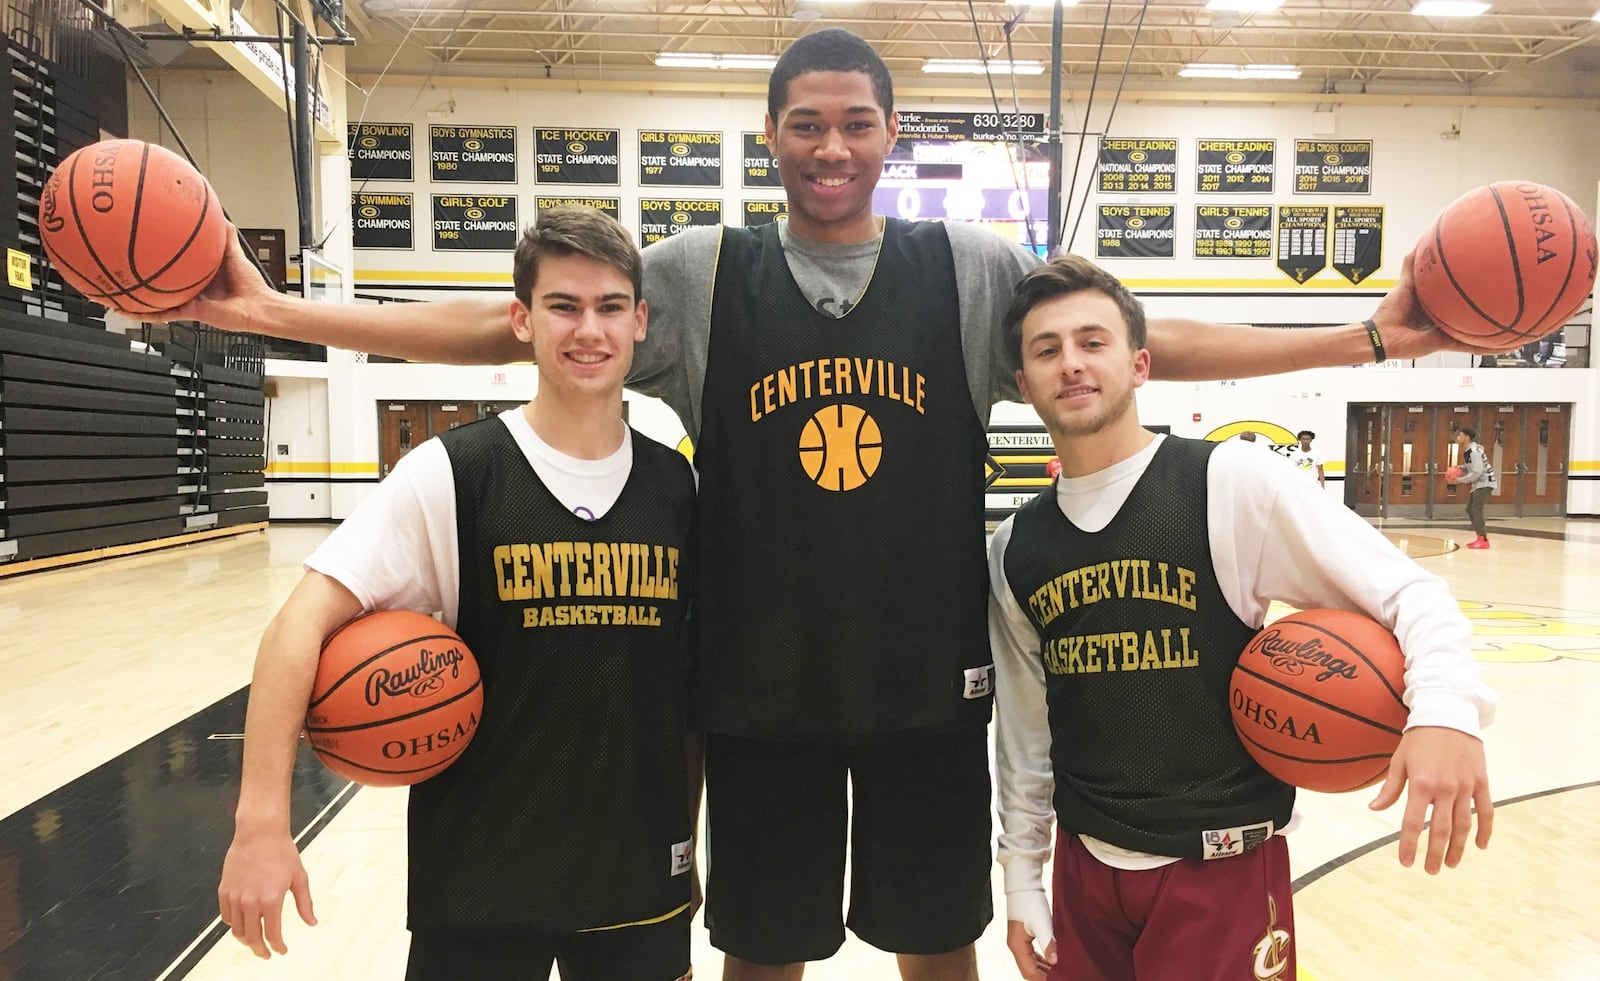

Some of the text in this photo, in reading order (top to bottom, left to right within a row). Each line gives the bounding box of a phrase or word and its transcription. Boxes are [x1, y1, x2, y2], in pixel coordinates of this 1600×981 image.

[362, 126, 409, 136] BOWLING
[433, 128, 513, 139] BOYS GYMNASTICS
[542, 131, 611, 141] ICE HOCKEY
[641, 133, 720, 144] GIRLS GYMNASTICS
[1103, 141, 1175, 150] CHEERLEADING
[1200, 142, 1273, 151] CHEERLEADING
[1297, 143, 1369, 152] GIRLS CROSS COUNTRY
[358, 149, 411, 160] CHAMPIONS
[433, 152, 514, 163] STATE CHAMPIONS
[537, 154, 617, 164] STATE CHAMPIONS
[641, 156, 720, 167] STATE CHAMPIONS
[744, 158, 769, 168] STATE
[881, 165, 918, 178] LACK
[1100, 164, 1175, 173] NATIONAL CHAMPIONS
[1198, 164, 1273, 173] STATE CHAMPIONS
[1295, 166, 1370, 175] STATE CHAMPIONS
[1103, 173, 1124, 181] 2008
[1226, 175, 1245, 183] 2012
[1251, 175, 1270, 183] 2014
[1299, 175, 1317, 183] 2014
[1153, 182, 1172, 190] 2015
[360, 195, 411, 206] SWIMMING
[440, 197, 508, 207] GIRLS GOLF
[539, 199, 561, 209] BOYS
[642, 201, 720, 211] BOYS SOCCER
[747, 203, 779, 212] GIRLS
[1103, 207, 1171, 216] BOYS TENNIS
[1200, 207, 1269, 217] GIRLS TENNIS
[358, 218, 410, 229] CHAMPIONS
[435, 221, 516, 231] STATE CHAMPIONS
[642, 224, 667, 233] STATE
[1516, 184, 1557, 266] OHSAA
[439, 231, 458, 239] 1995
[1099, 229, 1173, 239] STATE CHAMPIONS
[1196, 229, 1271, 239] STATE CHAMPIONS
[750, 357, 926, 423] CENTERVILLE
[989, 436, 1053, 445] CENTERVIL
[494, 541, 679, 601] CENTERVILLE
[1028, 559, 1197, 628] CENTERVILLE
[523, 605, 661, 628] BASKETBALL
[1250, 629, 1358, 682] Rawlings
[365, 646, 463, 707] Rawlings
[1233, 688, 1323, 744] OHSAA
[382, 712, 478, 759] OHSAA
